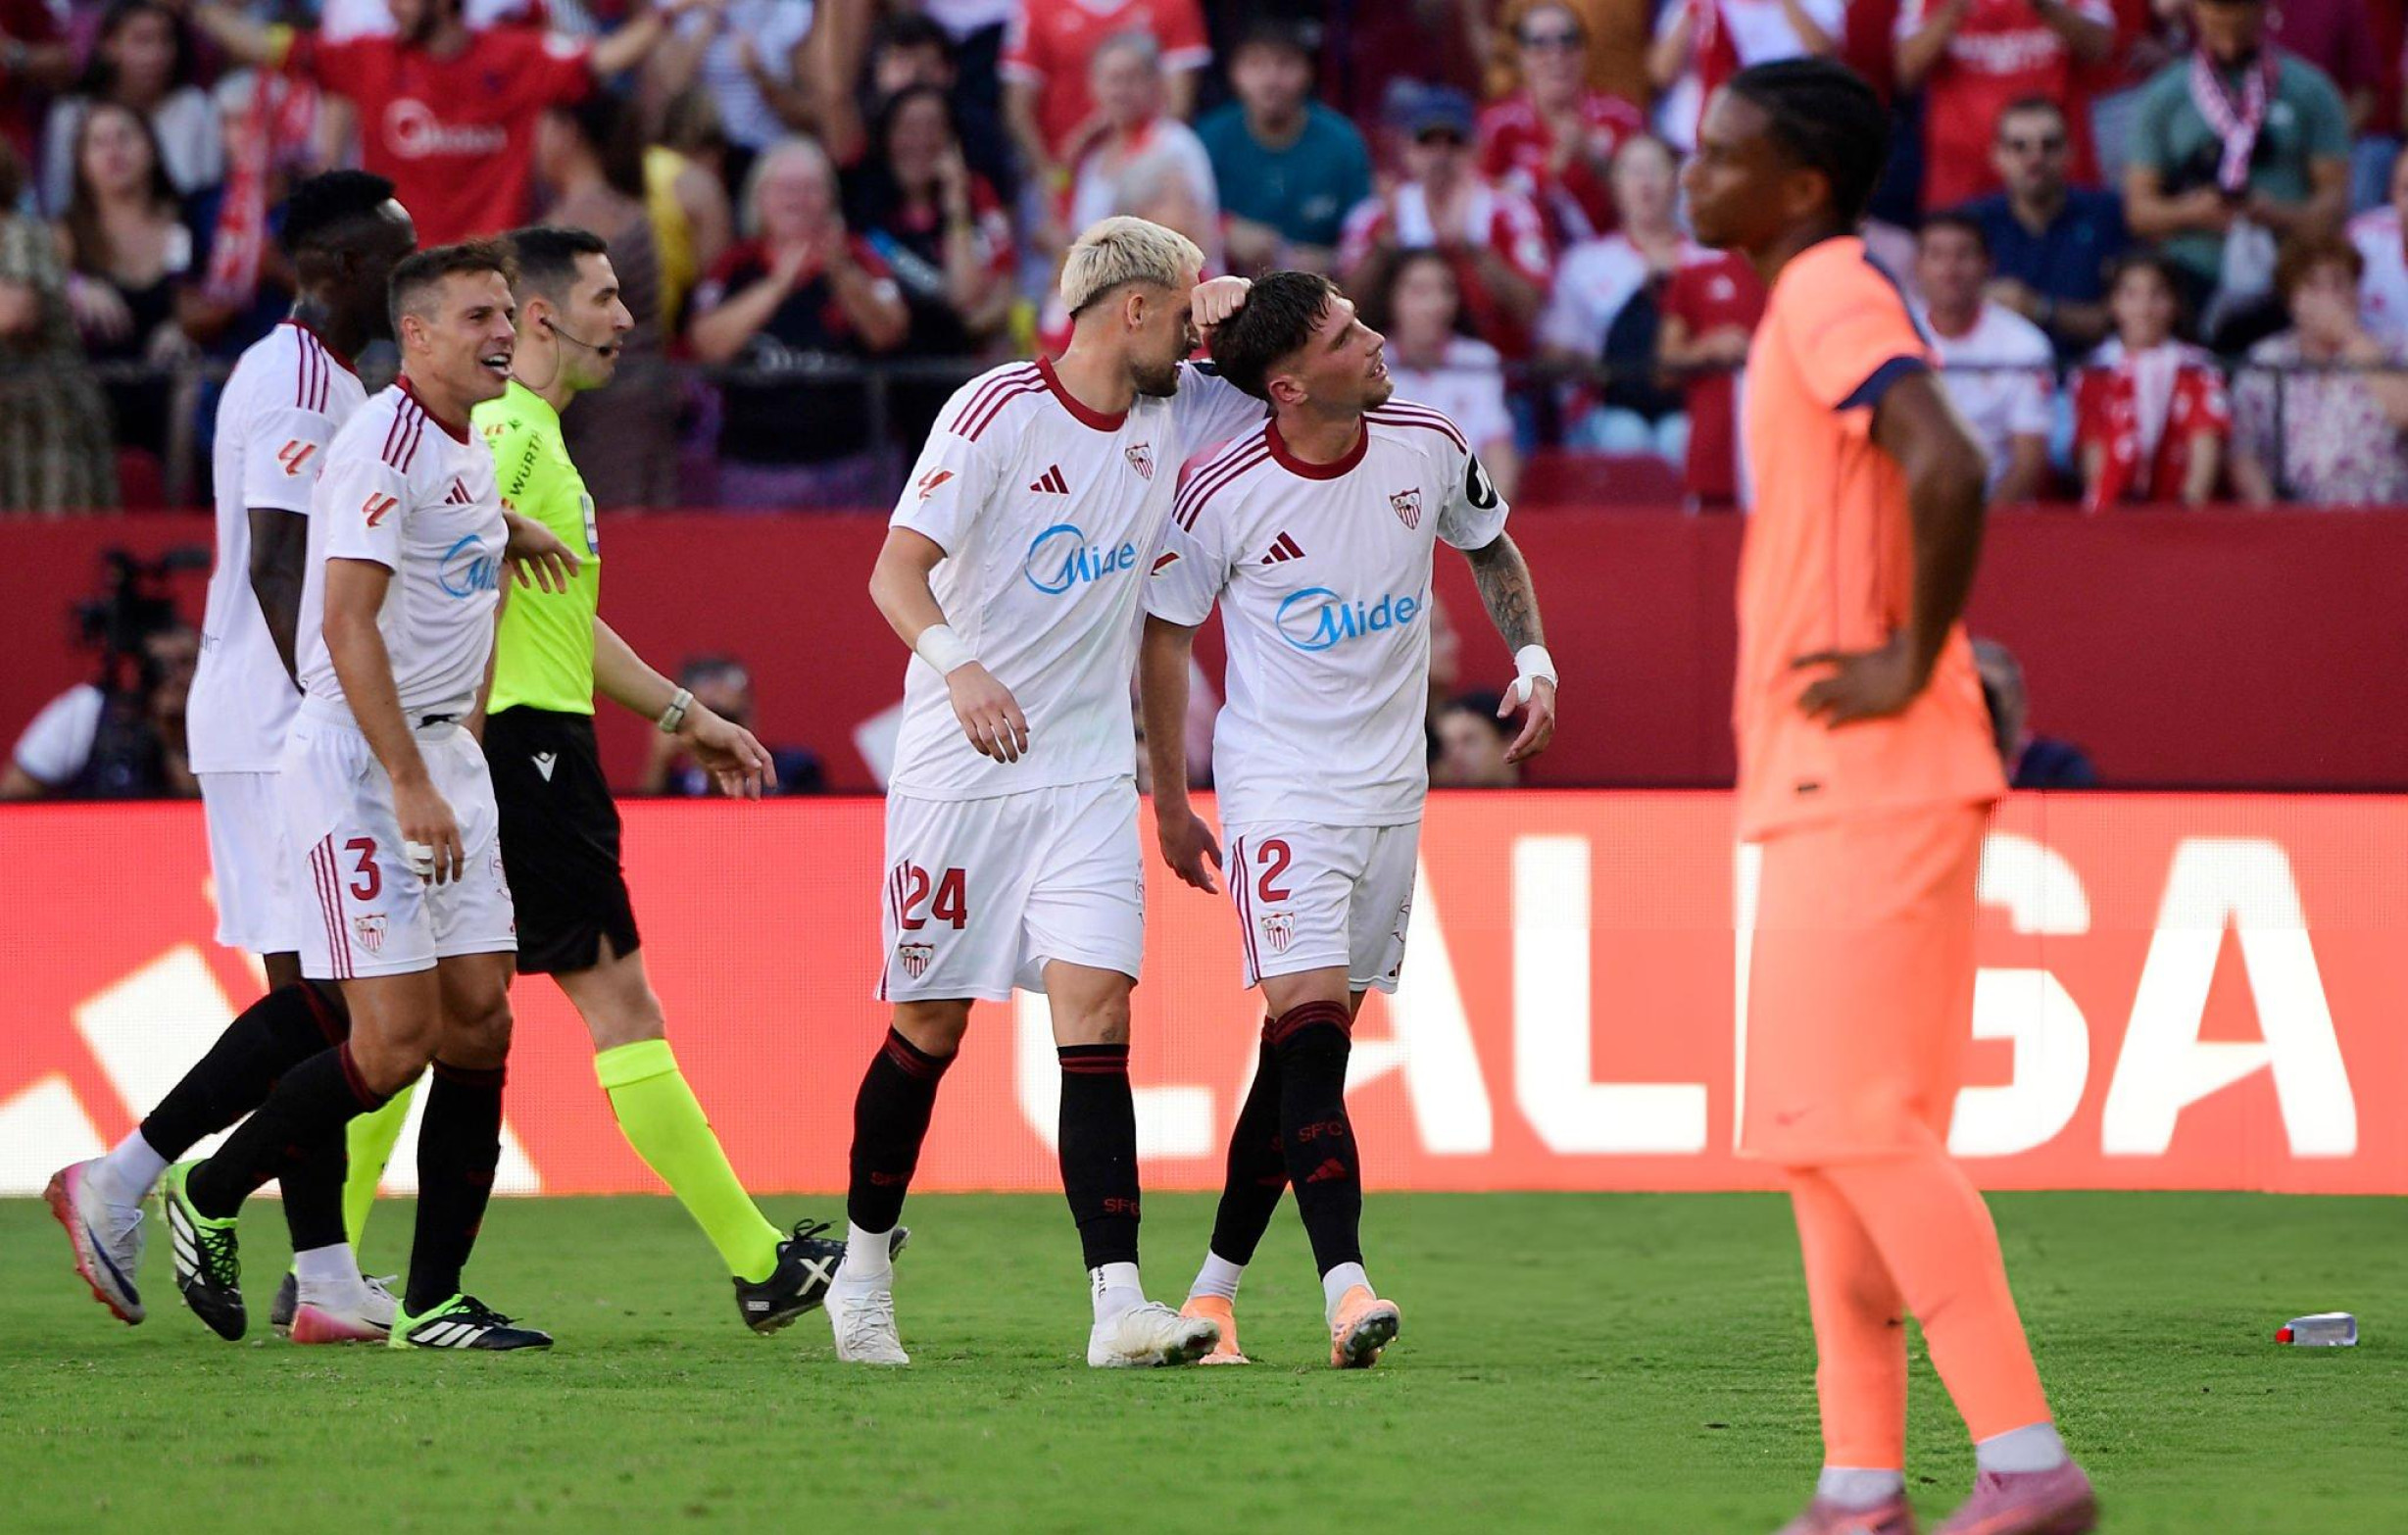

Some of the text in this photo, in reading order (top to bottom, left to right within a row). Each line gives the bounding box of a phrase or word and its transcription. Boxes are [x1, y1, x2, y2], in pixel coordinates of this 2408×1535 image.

[1024, 523, 1137, 595] Mide
[344, 837, 380, 901] 3
[902, 866, 967, 930] 24
[1257, 839, 1291, 903] 2
